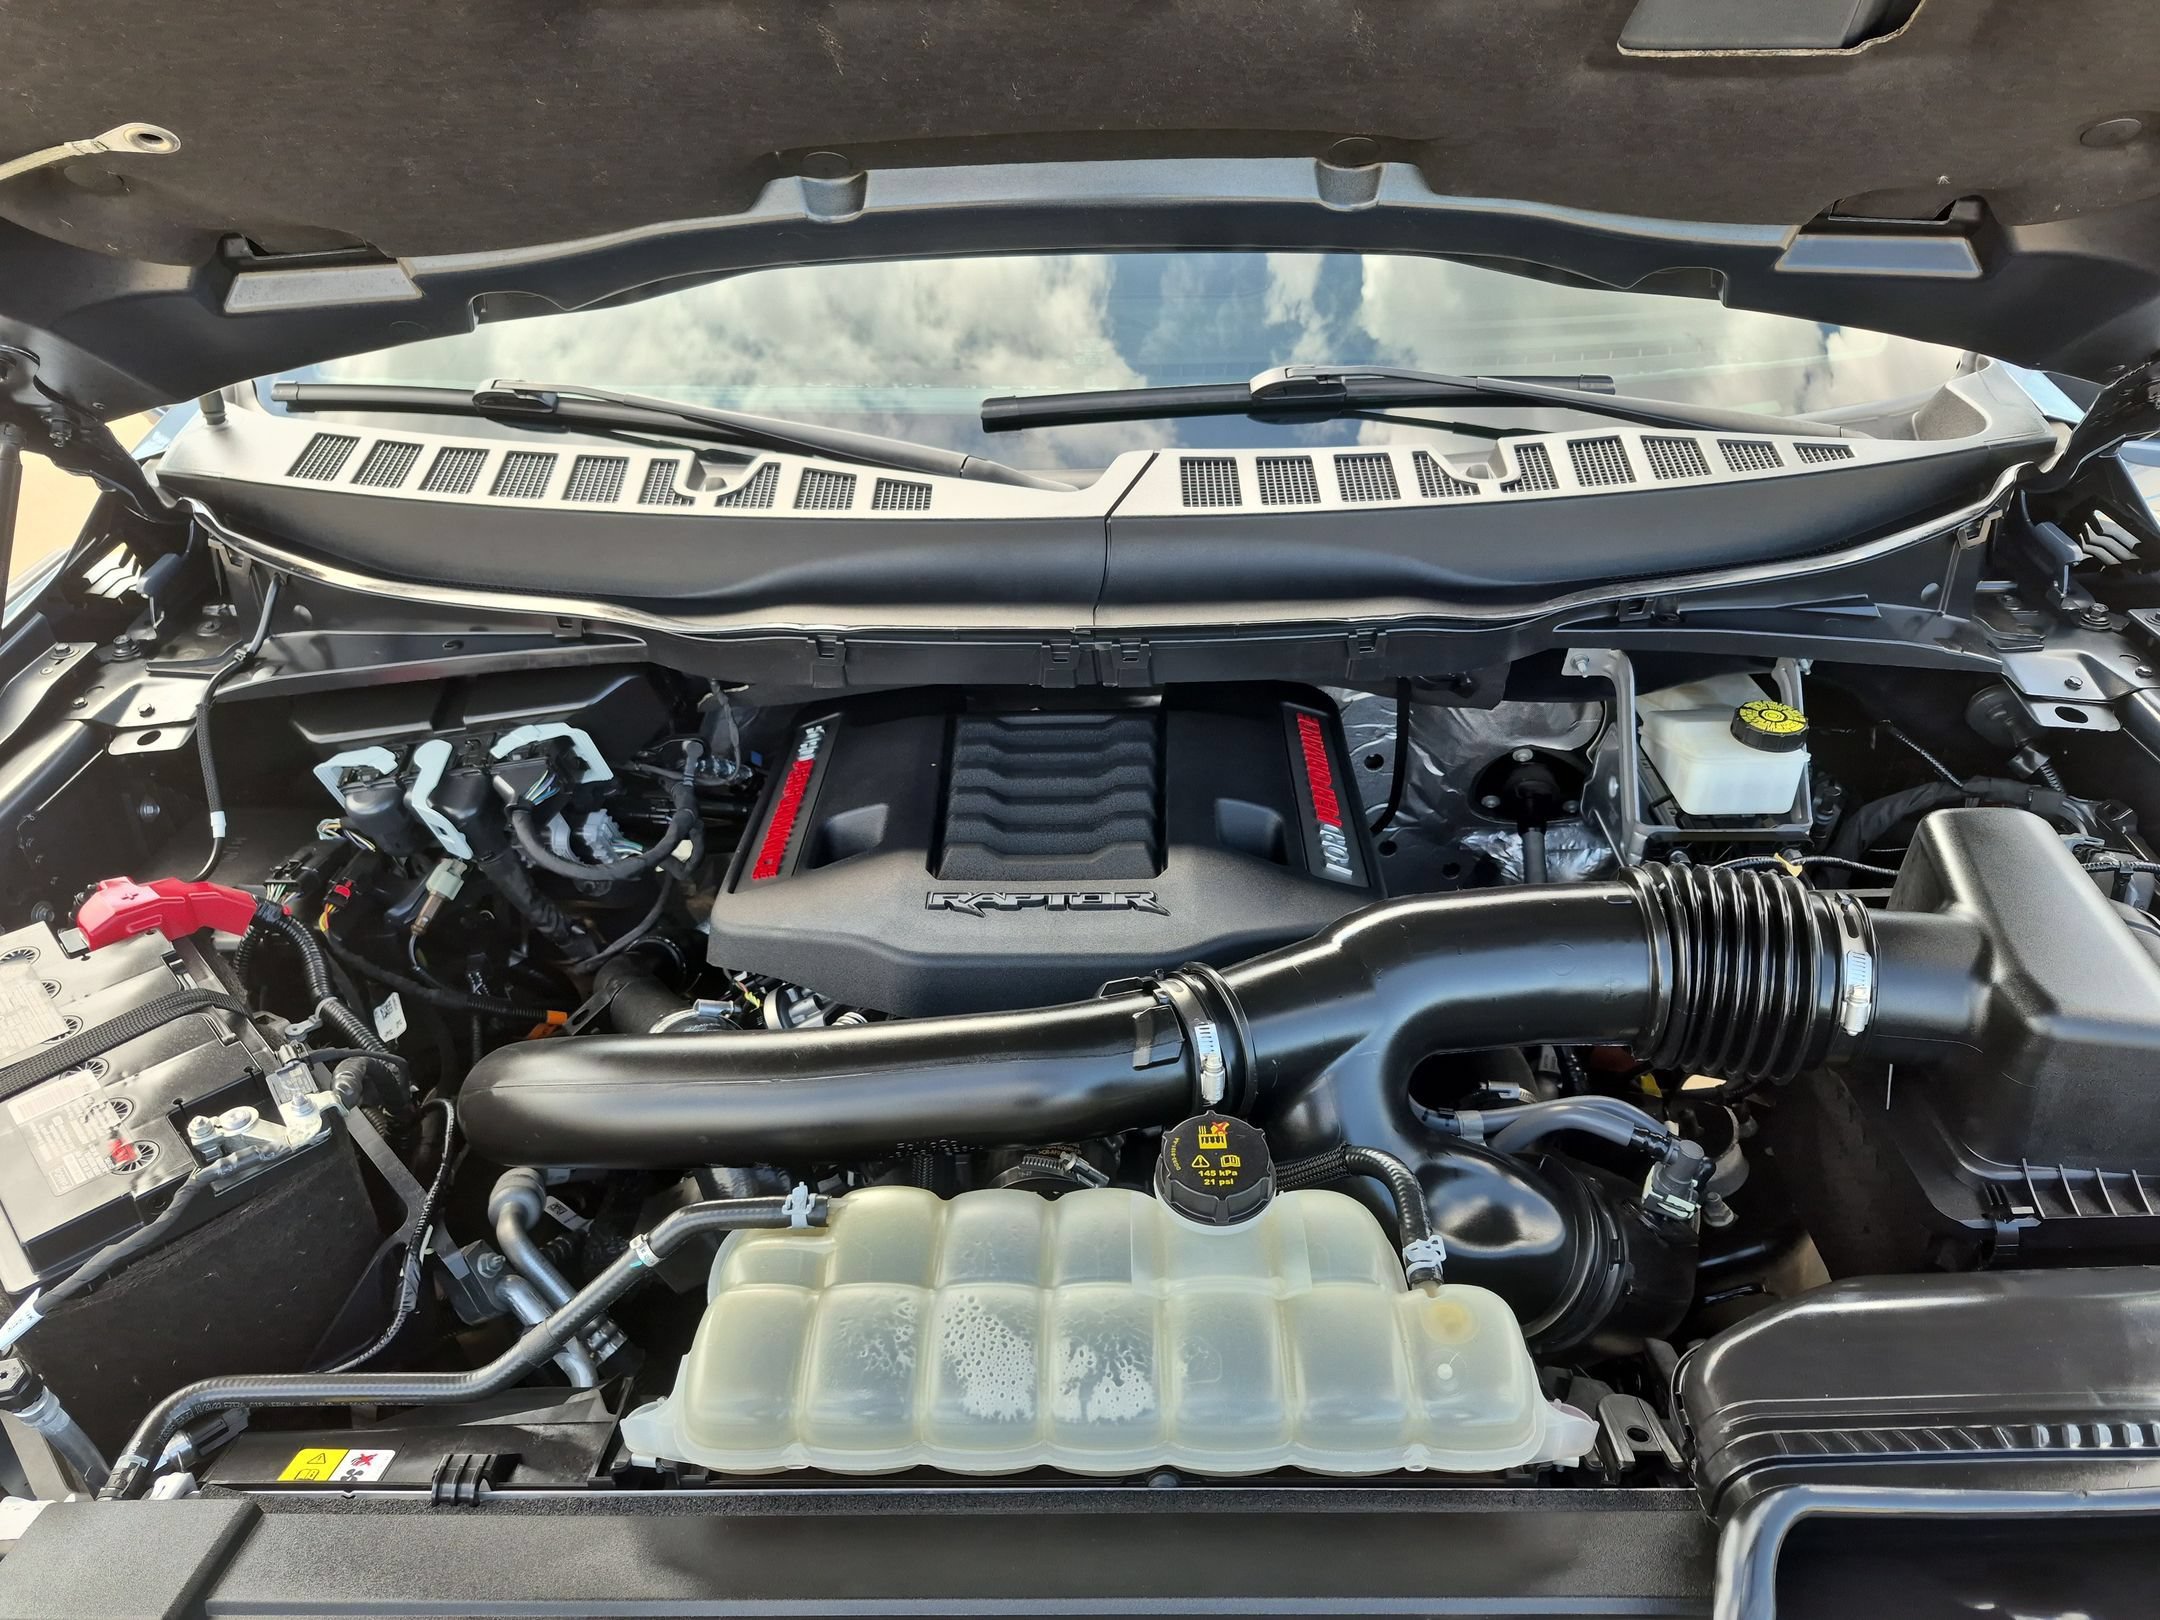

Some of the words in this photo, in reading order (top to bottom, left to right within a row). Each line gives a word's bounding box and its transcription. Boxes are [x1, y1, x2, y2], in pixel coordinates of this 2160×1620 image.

[1296, 711, 1343, 828] PERFORMANCE
[1319, 823, 1353, 877] FORD
[926, 891, 1171, 918] RAPTOR
[1219, 1179, 1234, 1187] psi
